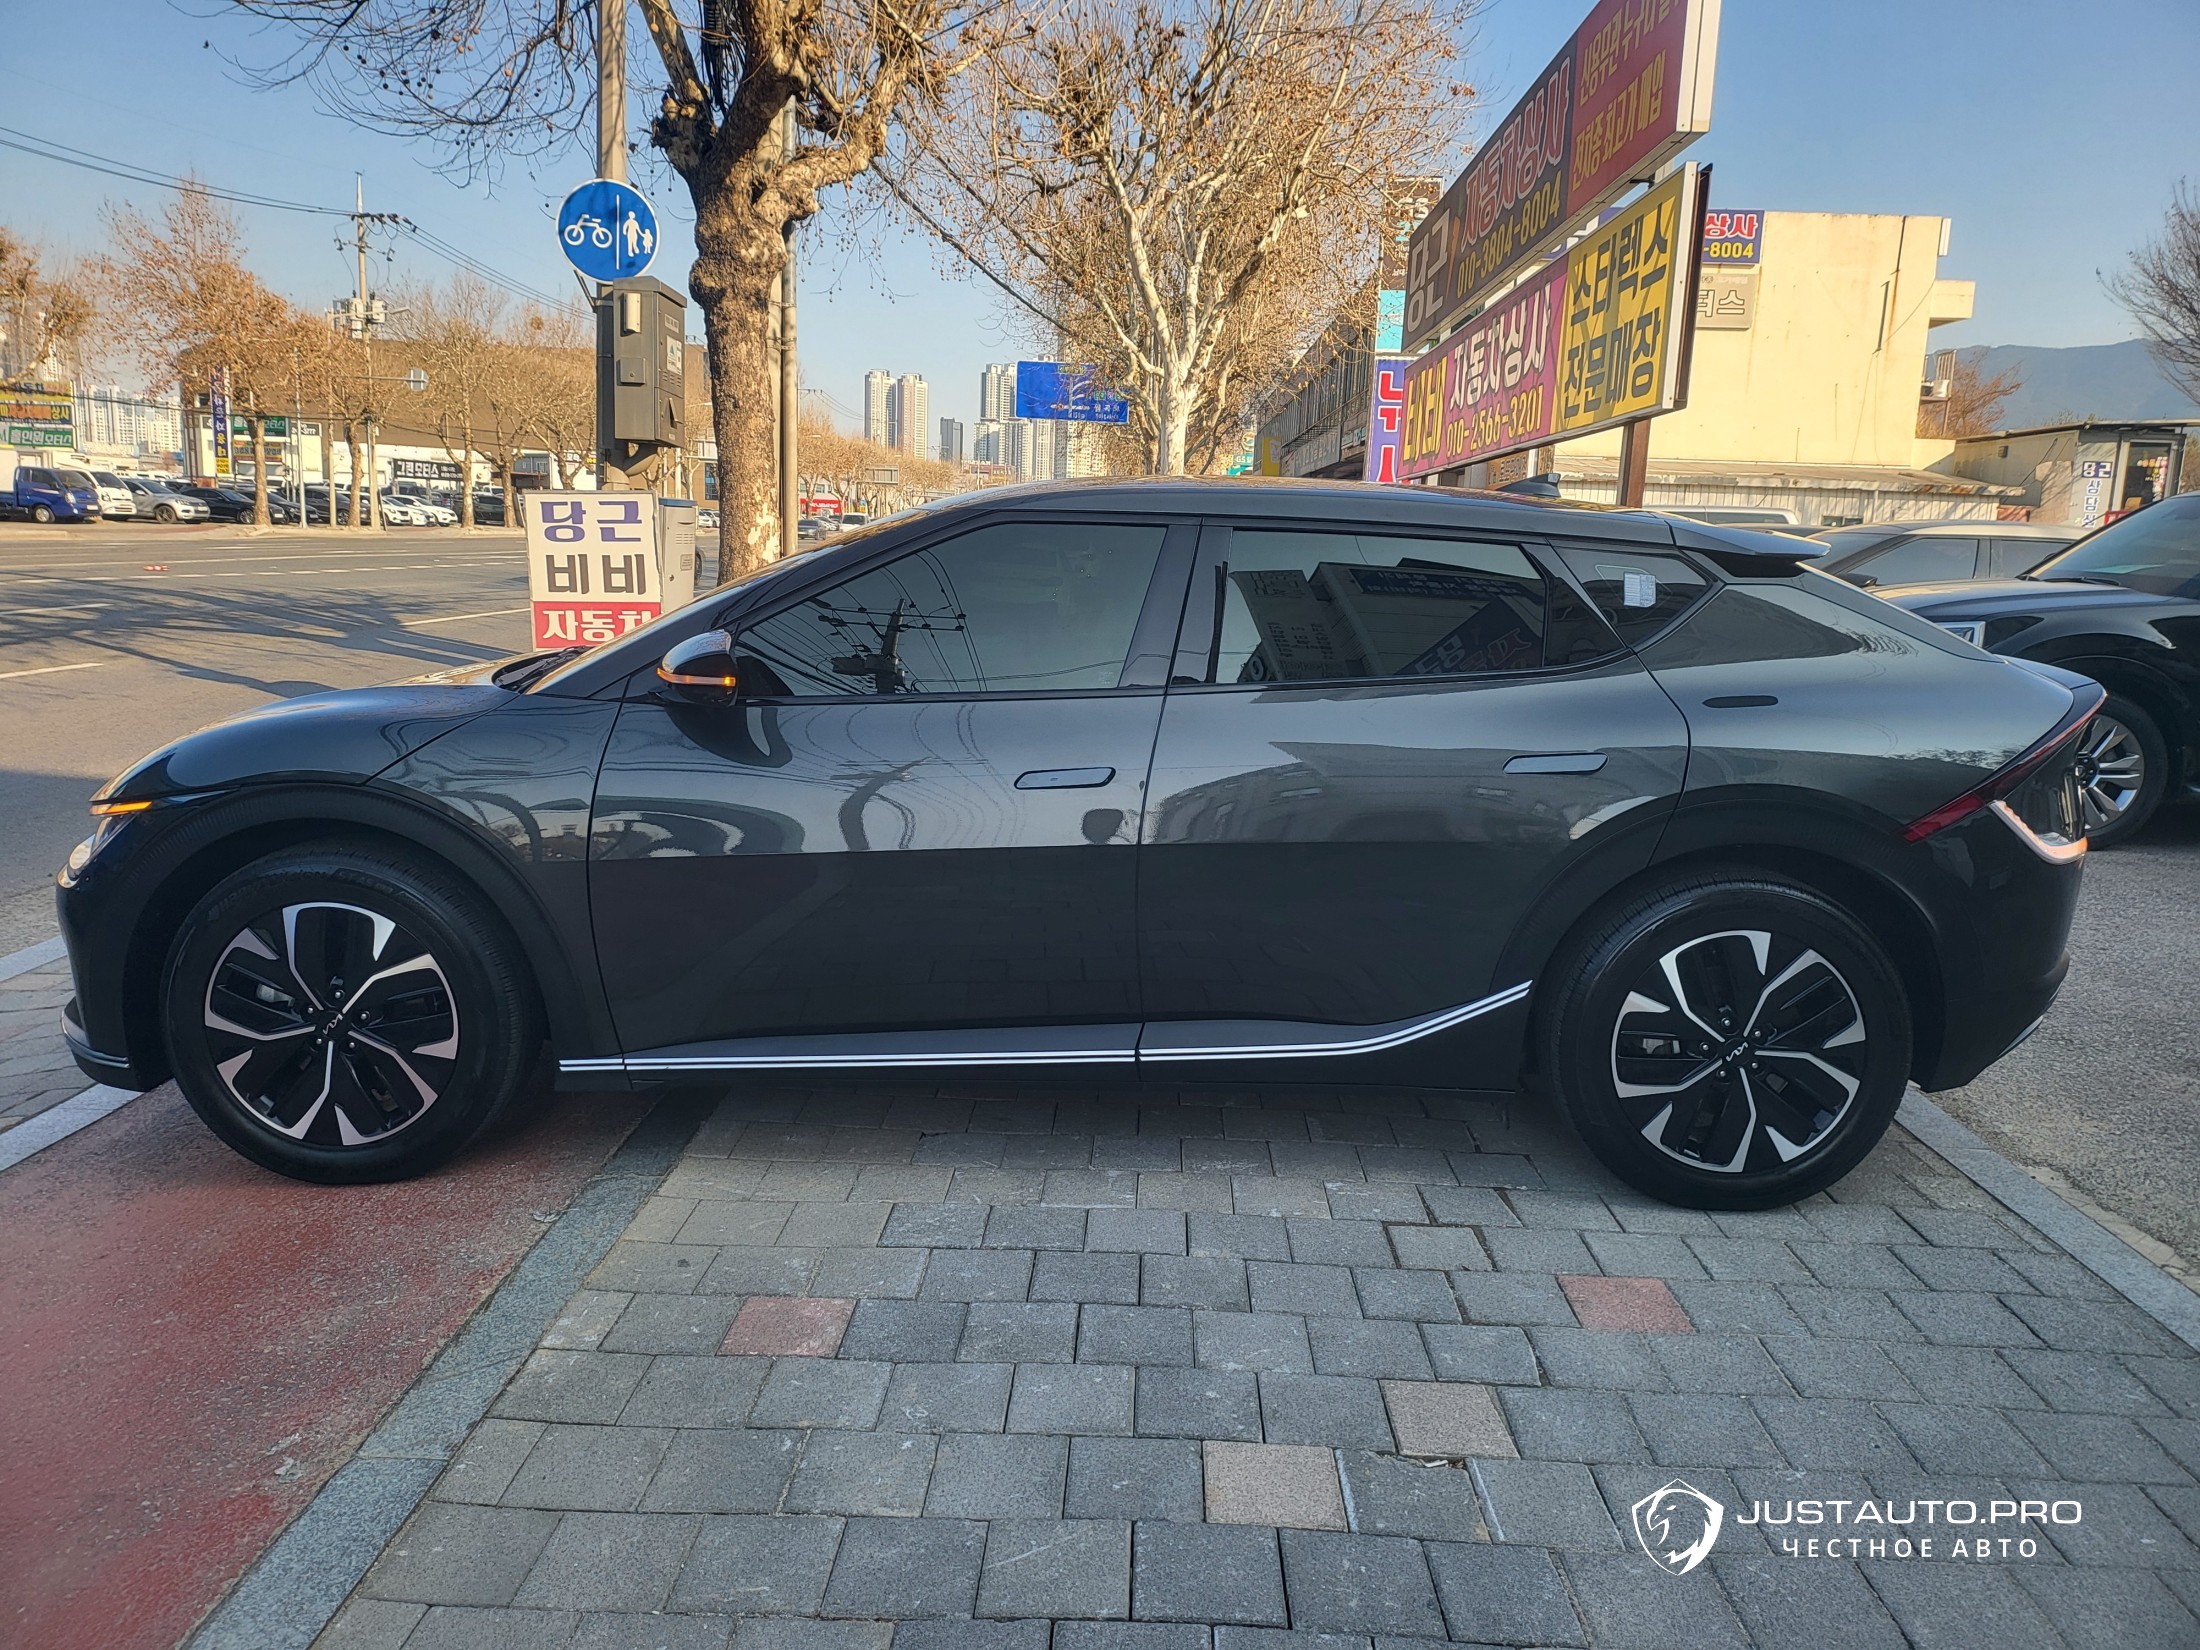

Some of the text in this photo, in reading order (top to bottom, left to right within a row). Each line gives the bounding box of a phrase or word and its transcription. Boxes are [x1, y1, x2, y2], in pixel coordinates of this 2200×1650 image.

[1406, 207, 1450, 333] 당근
[1461, 56, 1570, 253] 자동차상사
[1457, 170, 1562, 298] 010-3804-8004
[1570, 202, 1668, 327] 스타렉스
[1403, 355, 1447, 464] 비비
[1450, 282, 1551, 412] 자동차상사
[1446, 385, 1544, 457] 010-2566-3201
[1564, 307, 1661, 418] 전문매장
[540, 501, 642, 542] 당근
[546, 554, 646, 595] 비비
